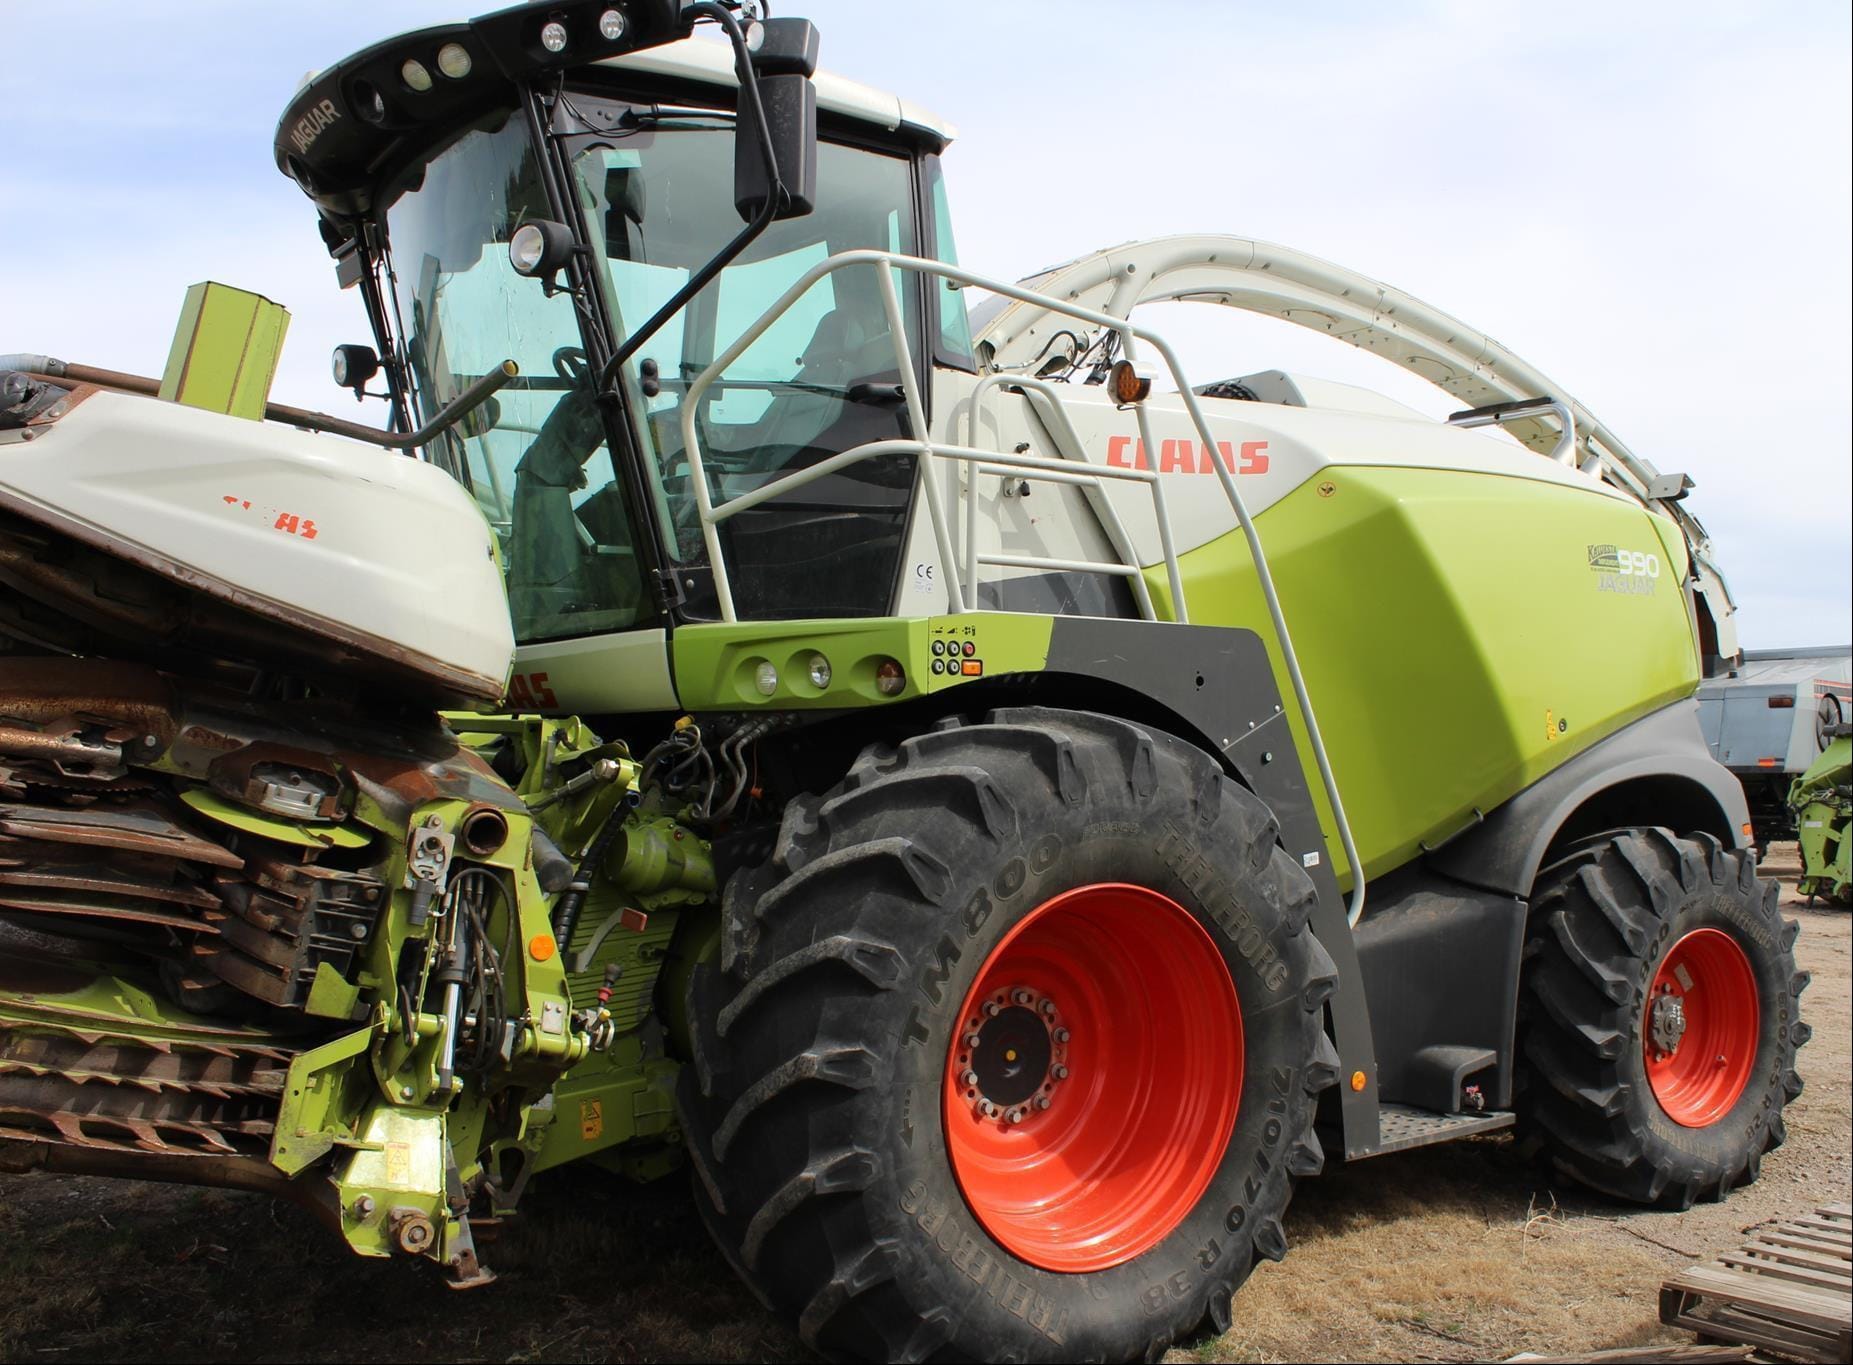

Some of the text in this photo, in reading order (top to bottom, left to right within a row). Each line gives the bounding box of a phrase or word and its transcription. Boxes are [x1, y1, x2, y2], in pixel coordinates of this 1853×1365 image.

[289, 98, 342, 155] JAGUAR
[1598, 573, 1656, 596] JAGUAR
[1617, 549, 1659, 578] 990
[1154, 818, 1289, 993] TRELLEBORG
[899, 1178, 1070, 1346] TRELLEBORG
